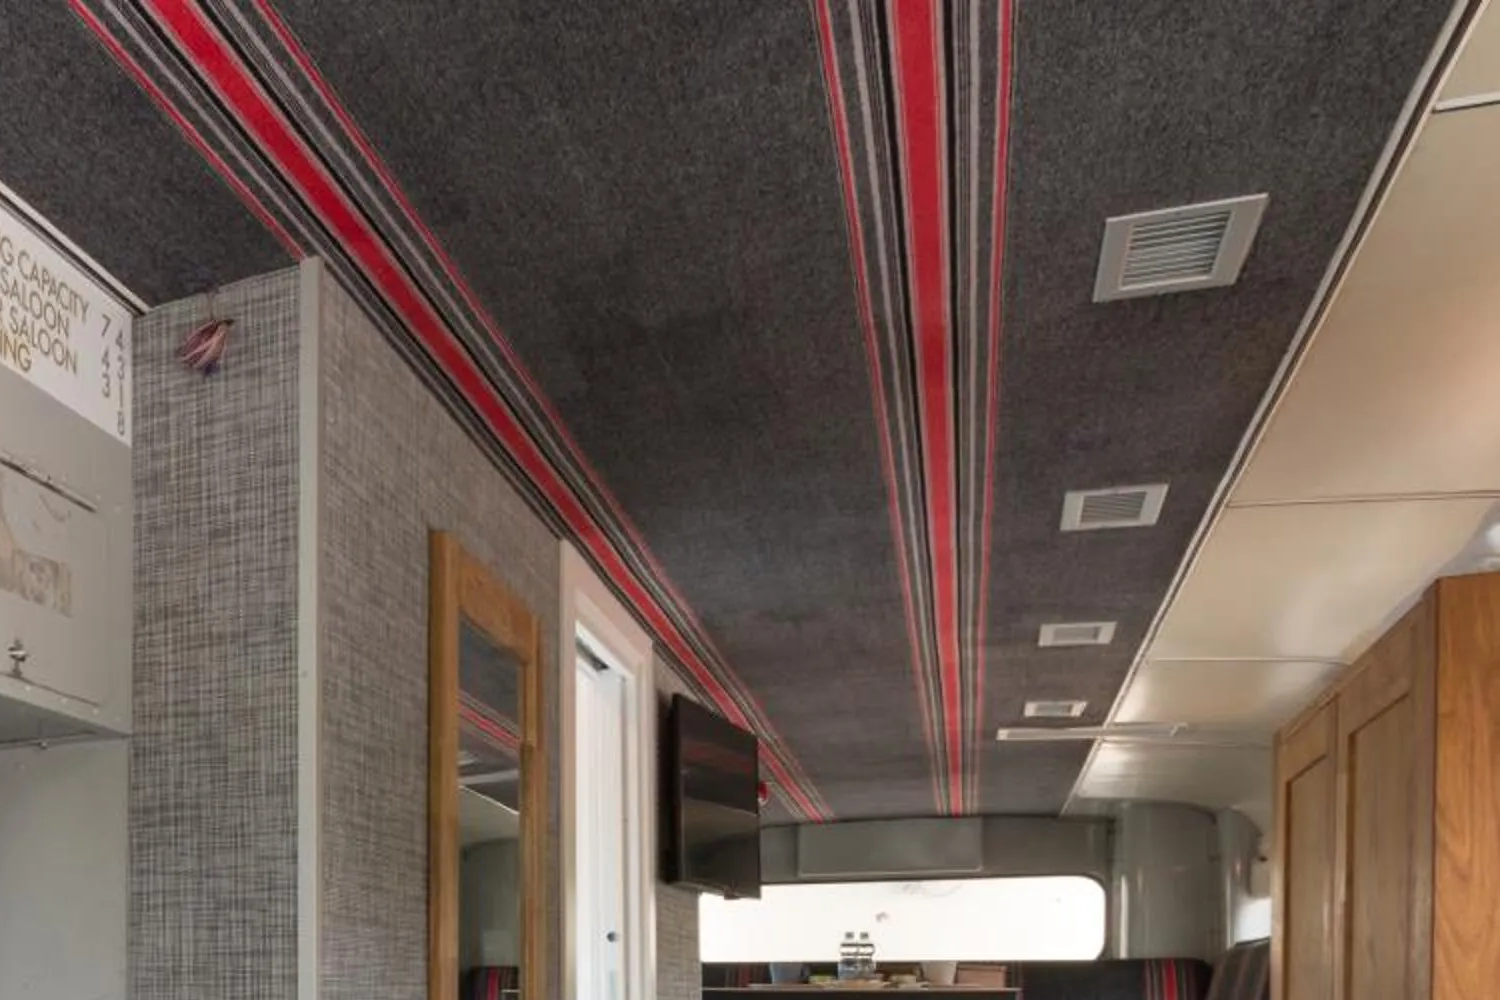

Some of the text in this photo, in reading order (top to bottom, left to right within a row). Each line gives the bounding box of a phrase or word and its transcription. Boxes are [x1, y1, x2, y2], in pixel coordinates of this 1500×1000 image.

[0, 268, 69, 337] SALOON
[17, 252, 89, 321] CAPACITY
[10, 308, 77, 374] SALOON
